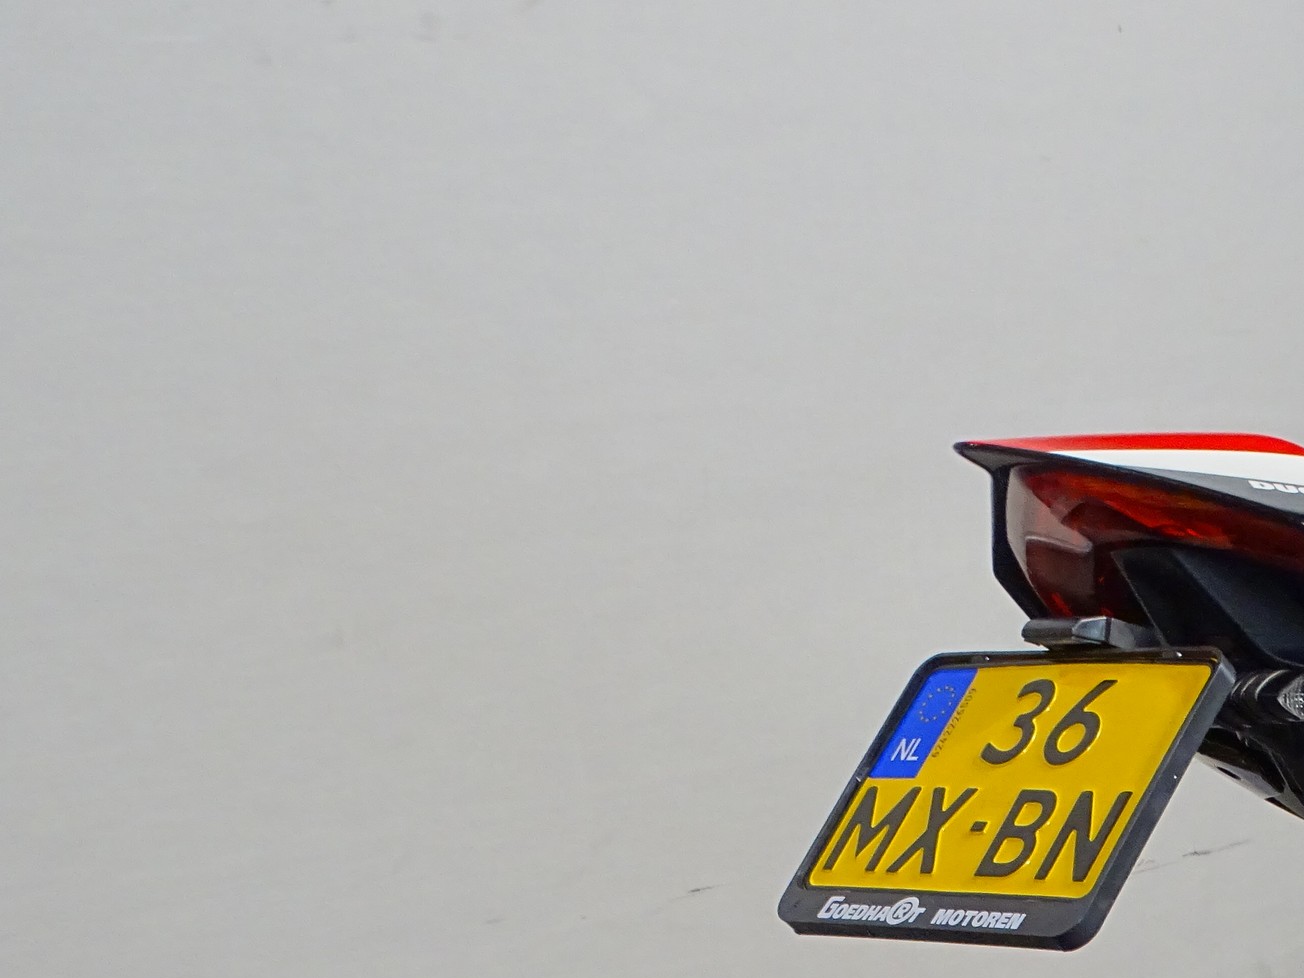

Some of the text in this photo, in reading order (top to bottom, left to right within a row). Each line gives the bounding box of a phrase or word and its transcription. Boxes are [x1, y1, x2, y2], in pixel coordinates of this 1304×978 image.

[890, 738, 922, 762] NL
[980, 678, 1118, 766] 36
[822, 786, 1133, 882] MX-BN
[930, 908, 1027, 930] MOTOREN
